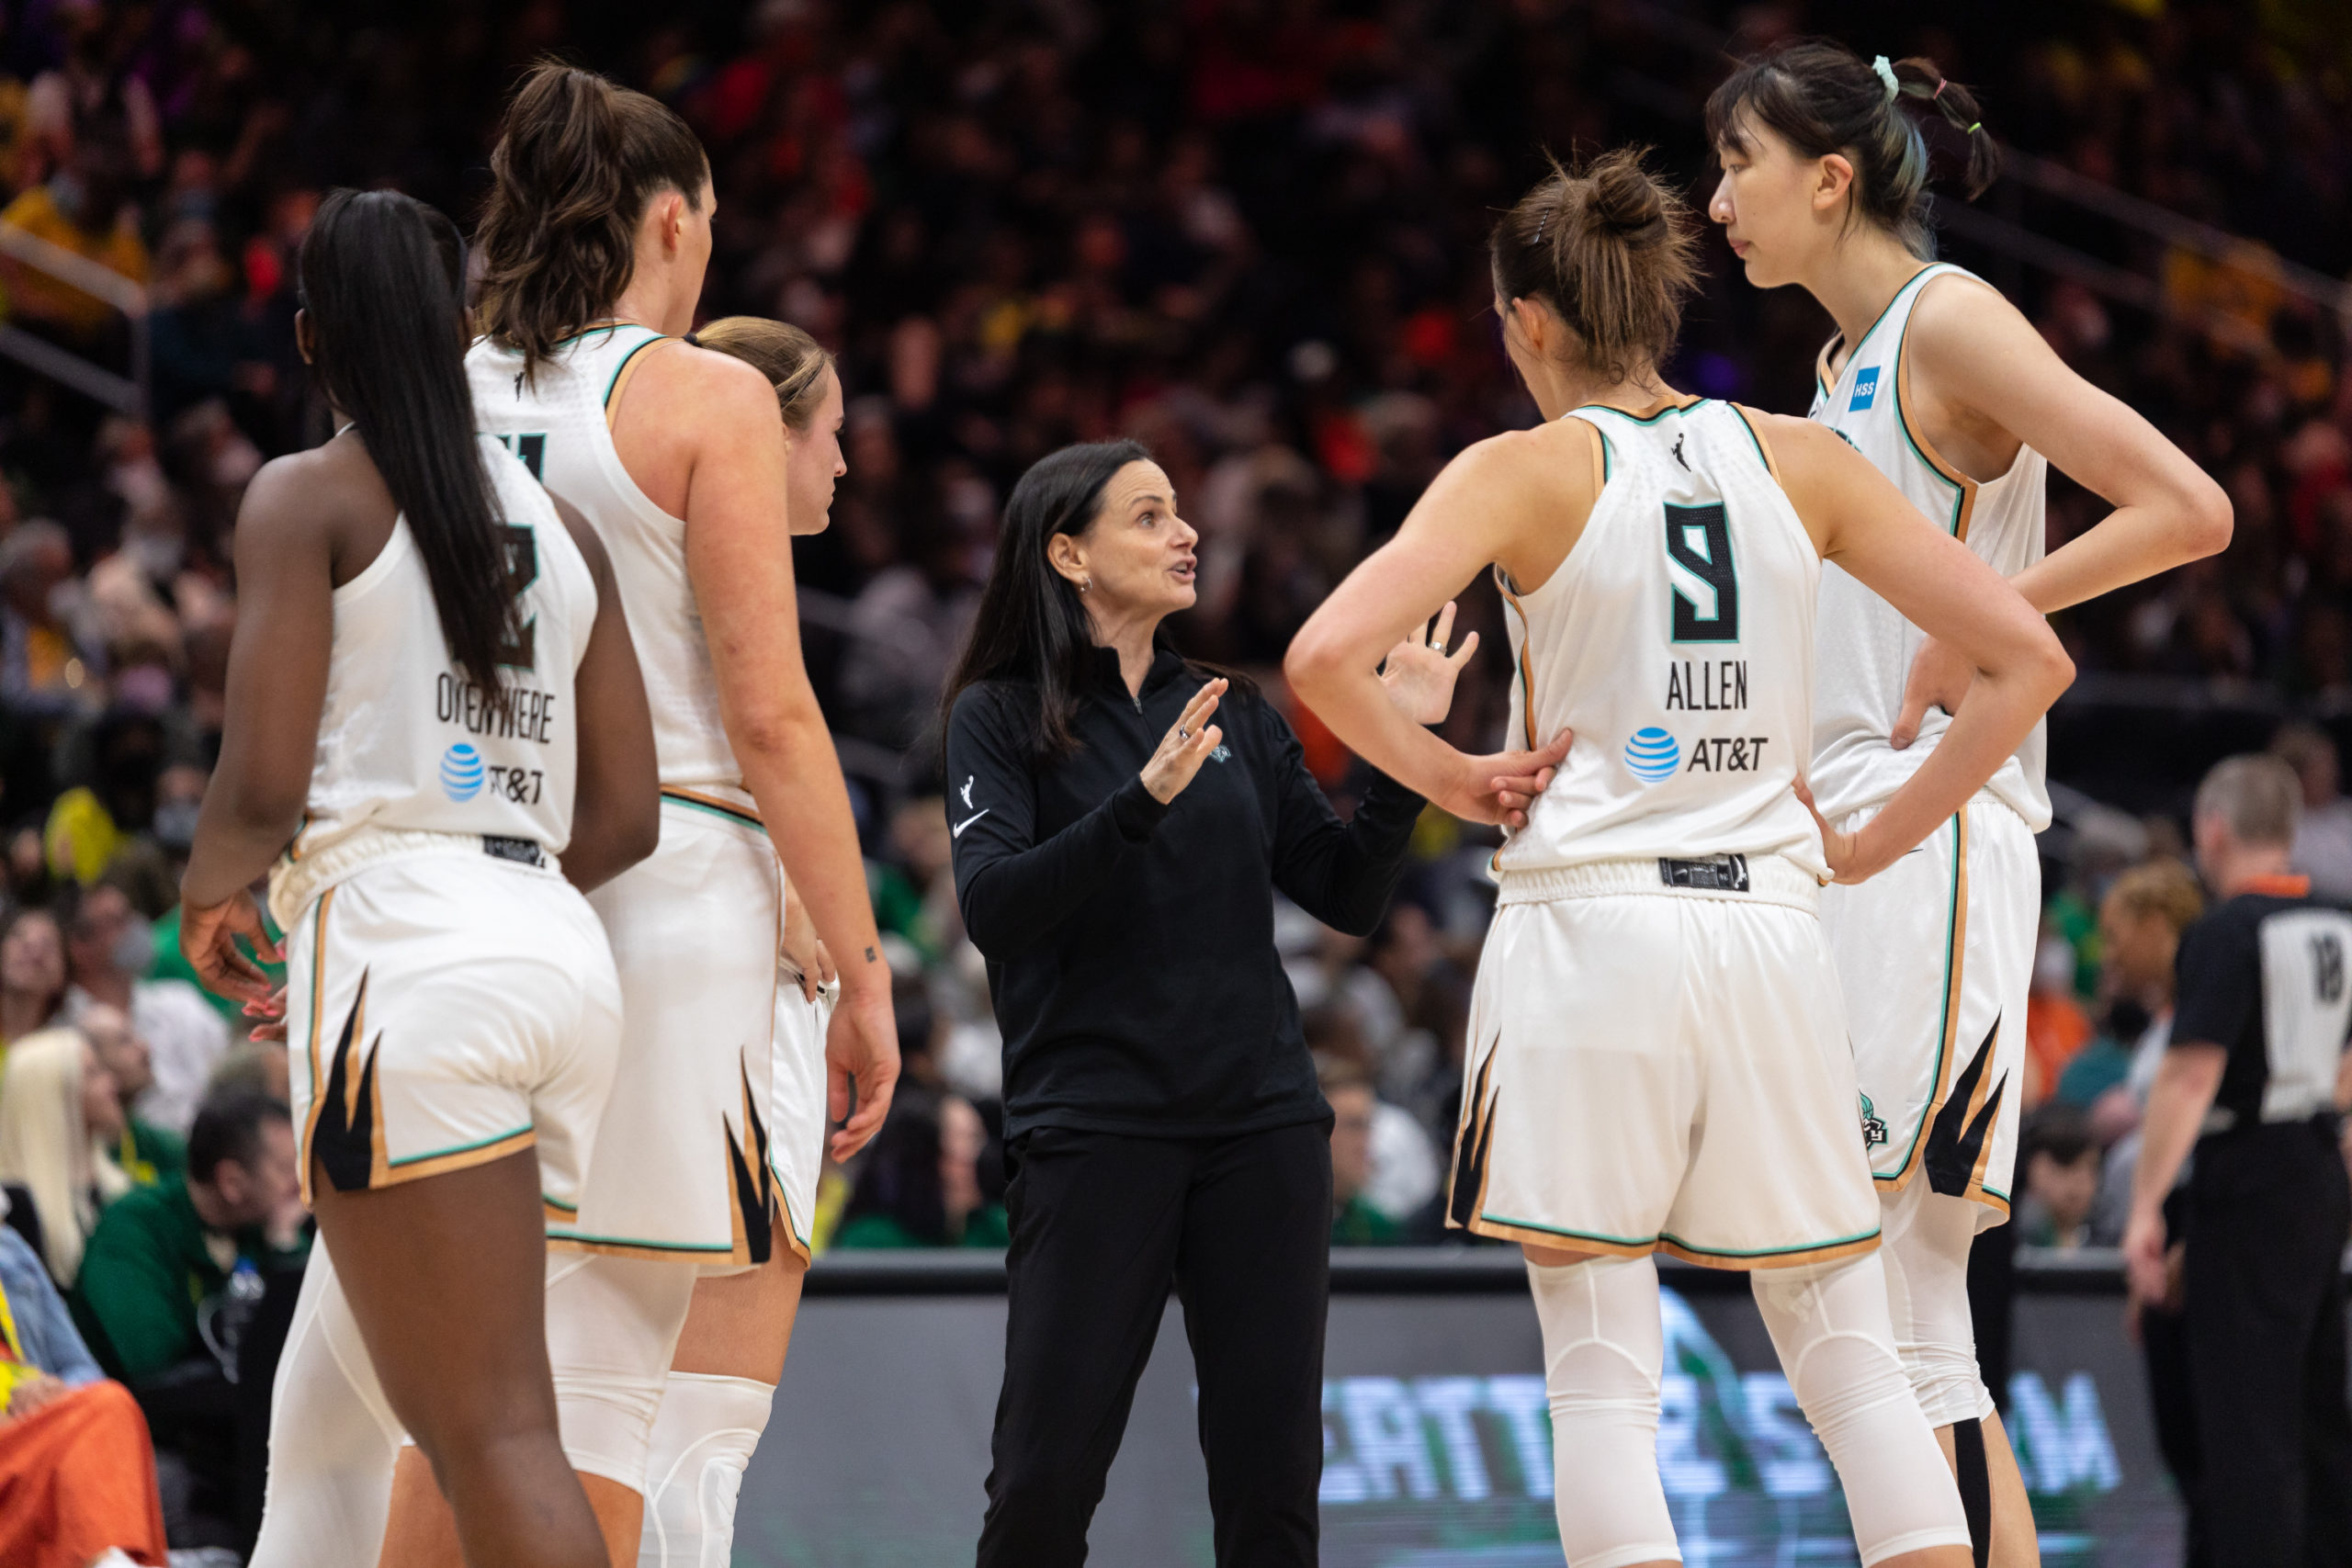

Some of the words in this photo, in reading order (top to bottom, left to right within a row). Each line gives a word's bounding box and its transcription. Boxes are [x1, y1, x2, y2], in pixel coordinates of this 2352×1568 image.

[1854, 382, 1875, 398] HSS
[1663, 501, 1740, 644] 9
[1666, 660, 1747, 710] ALLEN
[1687, 737, 1769, 773] AT&T
